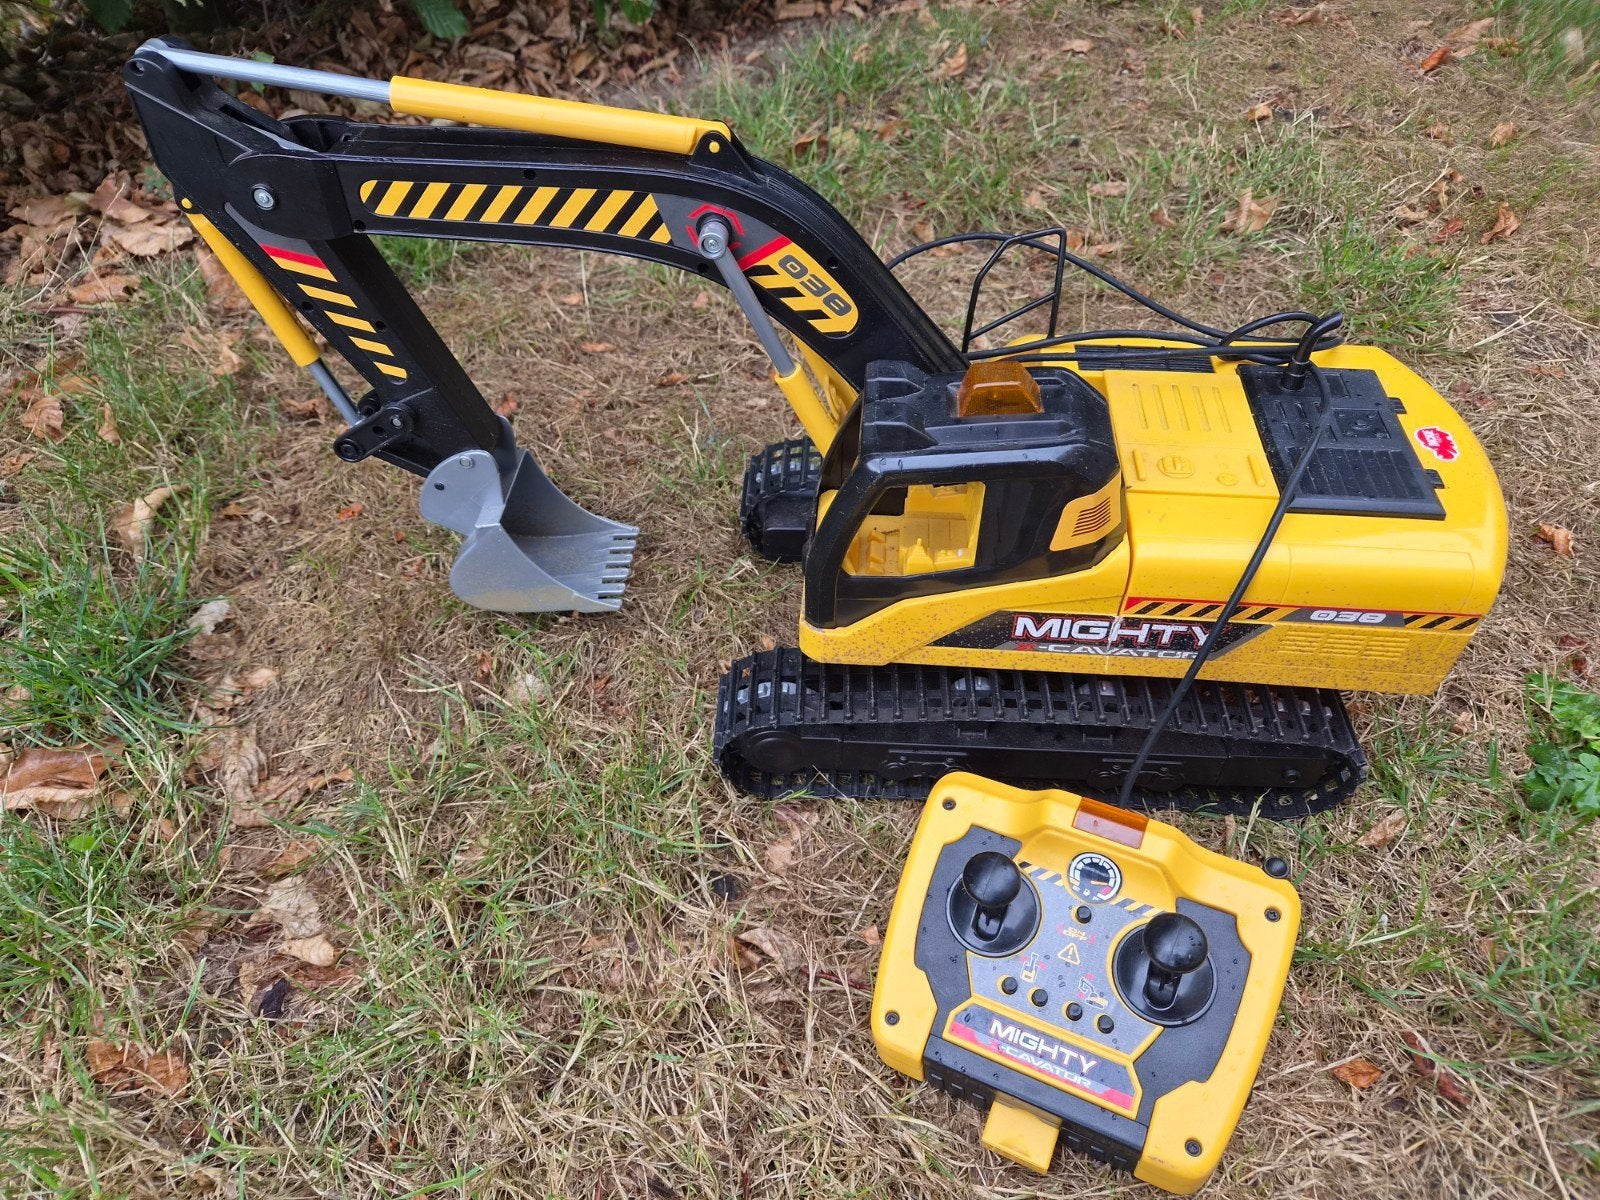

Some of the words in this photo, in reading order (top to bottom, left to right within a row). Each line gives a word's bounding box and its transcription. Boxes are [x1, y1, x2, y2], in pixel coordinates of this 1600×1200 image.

[778, 254, 852, 317] 038
[1012, 615, 1211, 649] MIGHTY
[1310, 608, 1387, 624] 038
[990, 1018, 1098, 1074] MIGHTY
